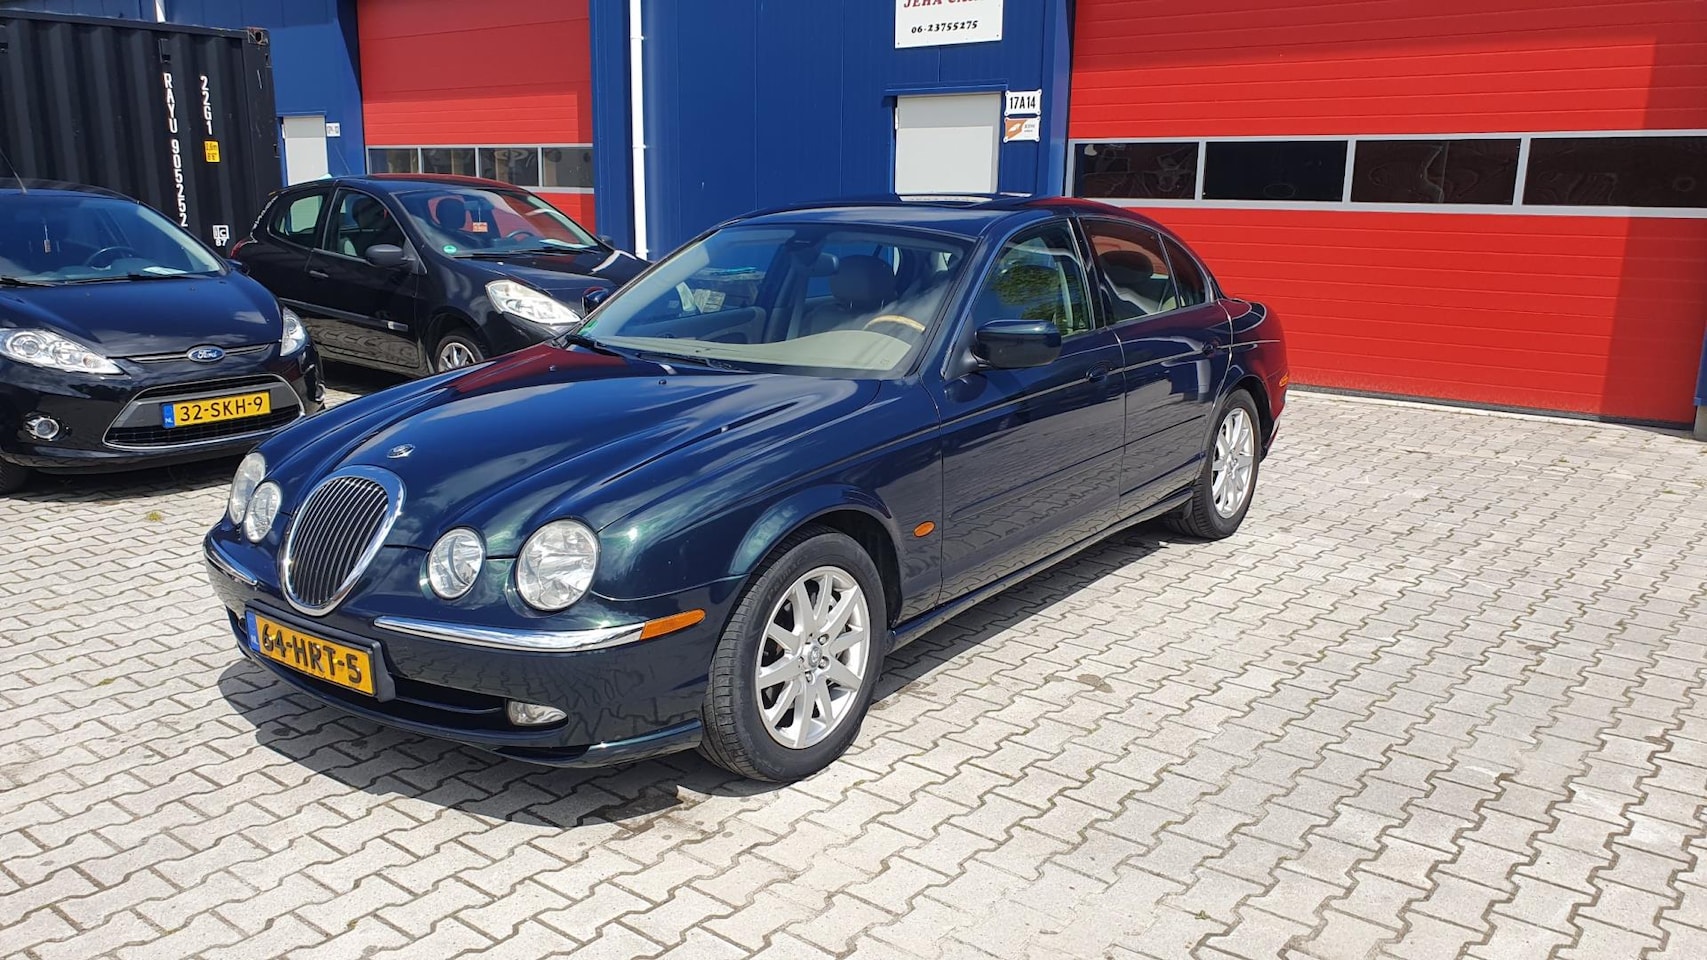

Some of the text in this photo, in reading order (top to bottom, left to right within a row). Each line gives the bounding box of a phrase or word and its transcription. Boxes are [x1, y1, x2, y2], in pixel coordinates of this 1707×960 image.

[911, 20, 978, 33] 06-23755275
[163, 72, 178, 134] RAYU
[200, 75, 213, 136] 22G1
[1010, 96, 1036, 110] 17A14
[197, 349, 217, 360] Ford
[180, 396, 263, 422] 32-SKH-9
[261, 623, 363, 685] 64-HRT-5
